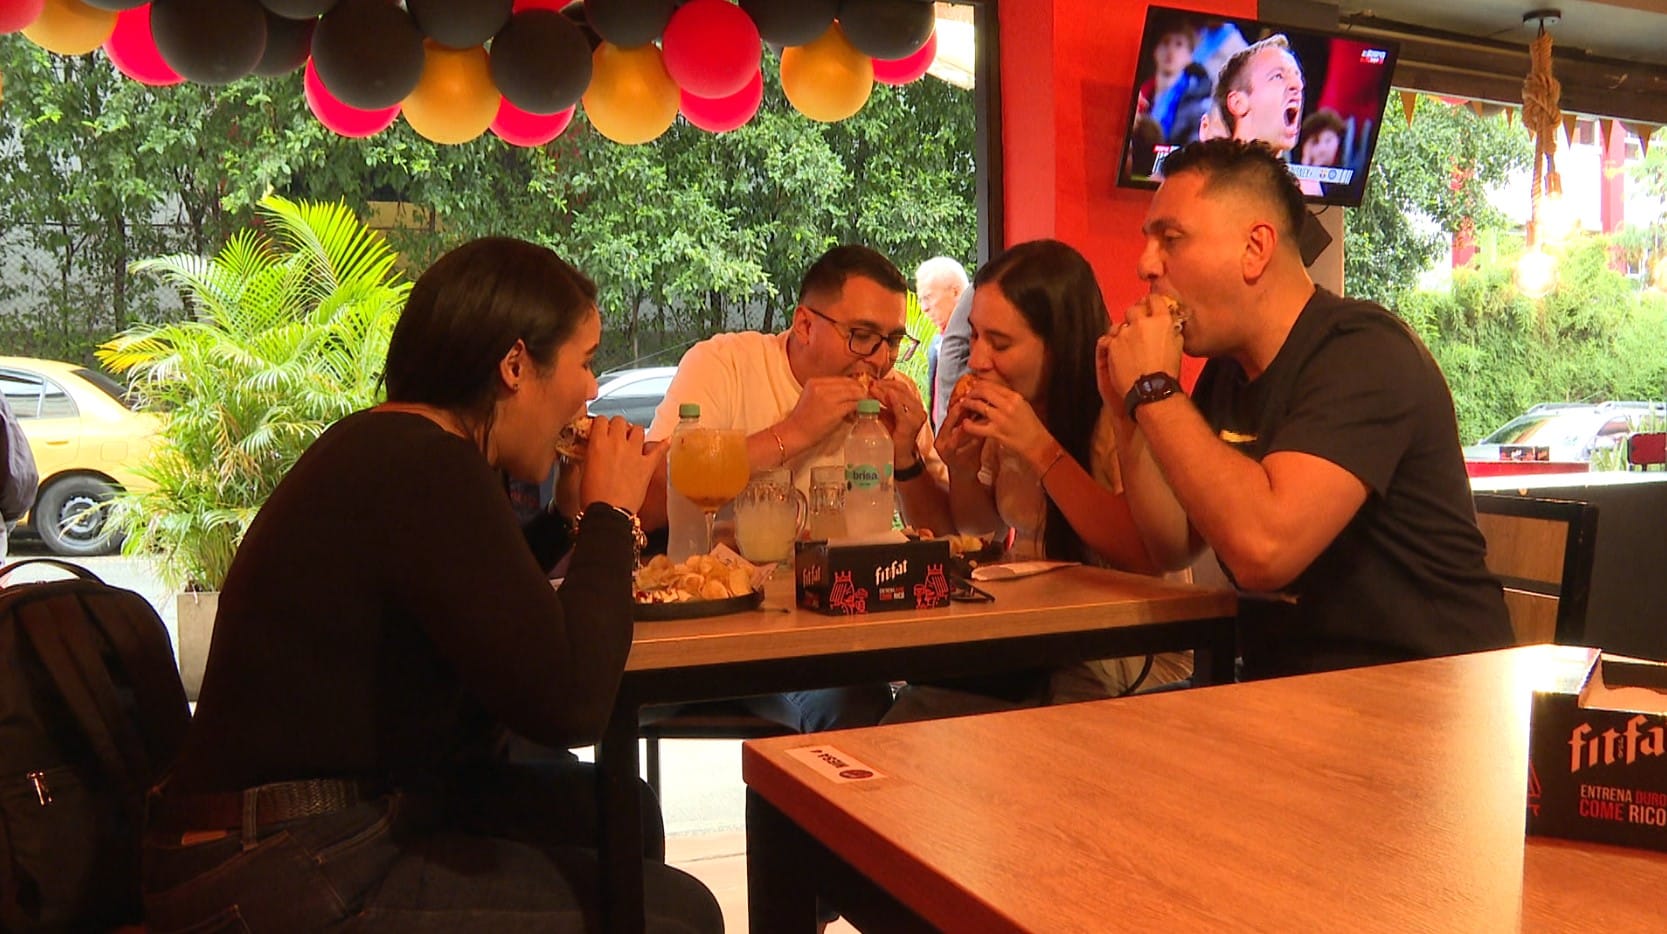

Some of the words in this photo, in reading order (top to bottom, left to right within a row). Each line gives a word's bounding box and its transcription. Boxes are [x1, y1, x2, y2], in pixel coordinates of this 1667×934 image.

[875, 559, 908, 586] fitfat
[1568, 715, 1667, 773] fitfa
[1581, 785, 1632, 802] ENTRENA
[1579, 800, 1624, 821] COME
[1629, 805, 1667, 826] RICO
